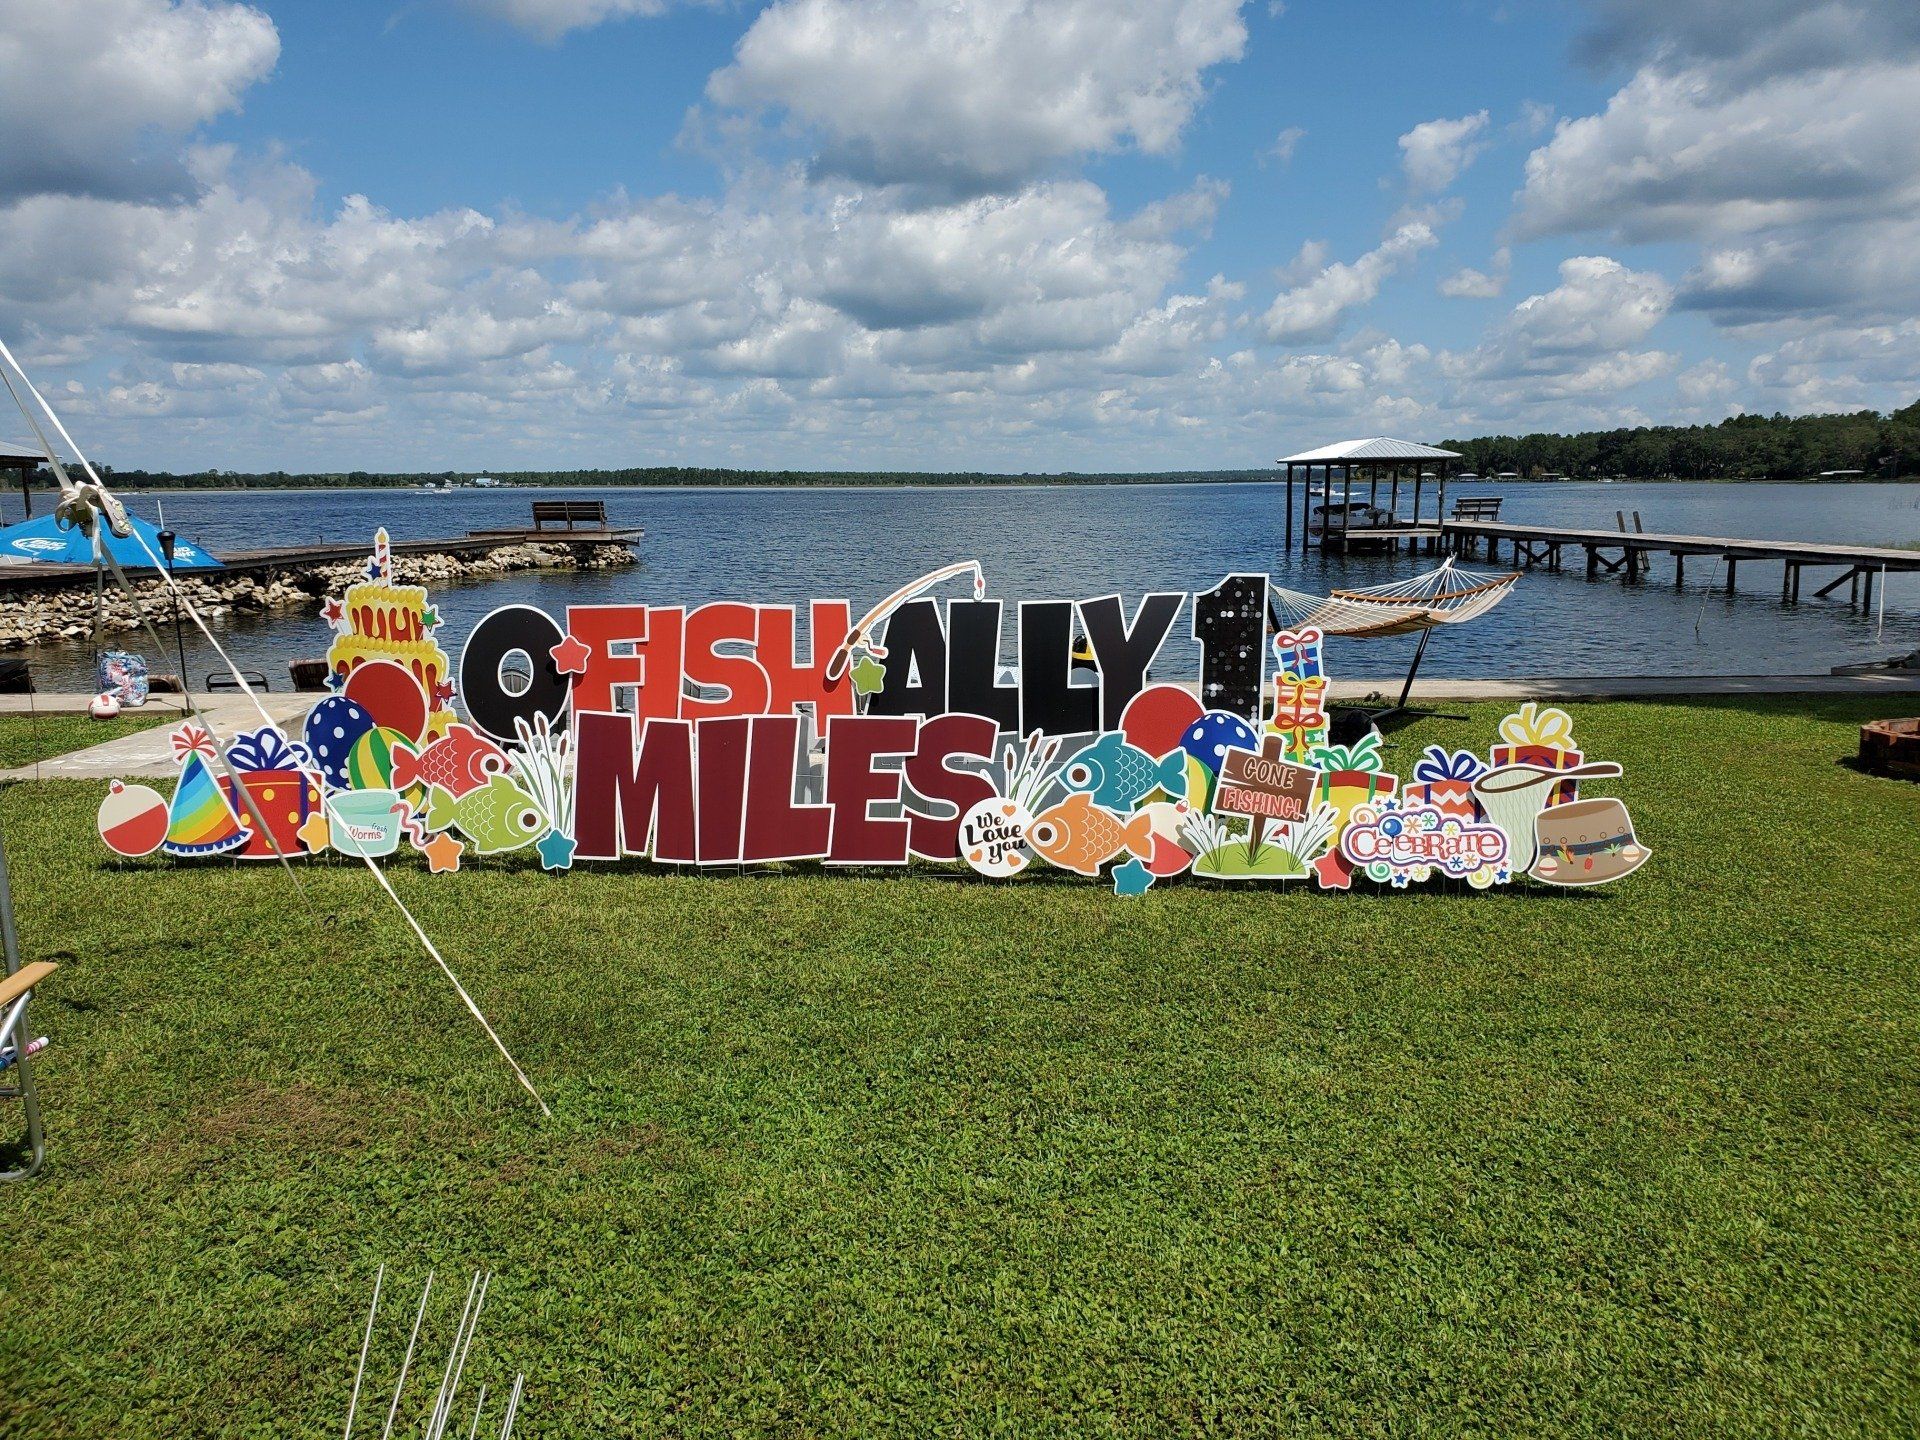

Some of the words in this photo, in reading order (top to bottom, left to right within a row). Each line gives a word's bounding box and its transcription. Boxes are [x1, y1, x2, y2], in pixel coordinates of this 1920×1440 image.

[1192, 573, 1269, 731] 1
[1243, 757, 1297, 789] GONE
[572, 710, 1000, 866] MILES
[1223, 787, 1302, 820] FISHING!
[349, 826, 382, 840] Worms
[371, 822, 388, 834] fresh
[976, 812, 1005, 829] We
[964, 824, 1022, 846] Love
[988, 838, 1028, 864] you
